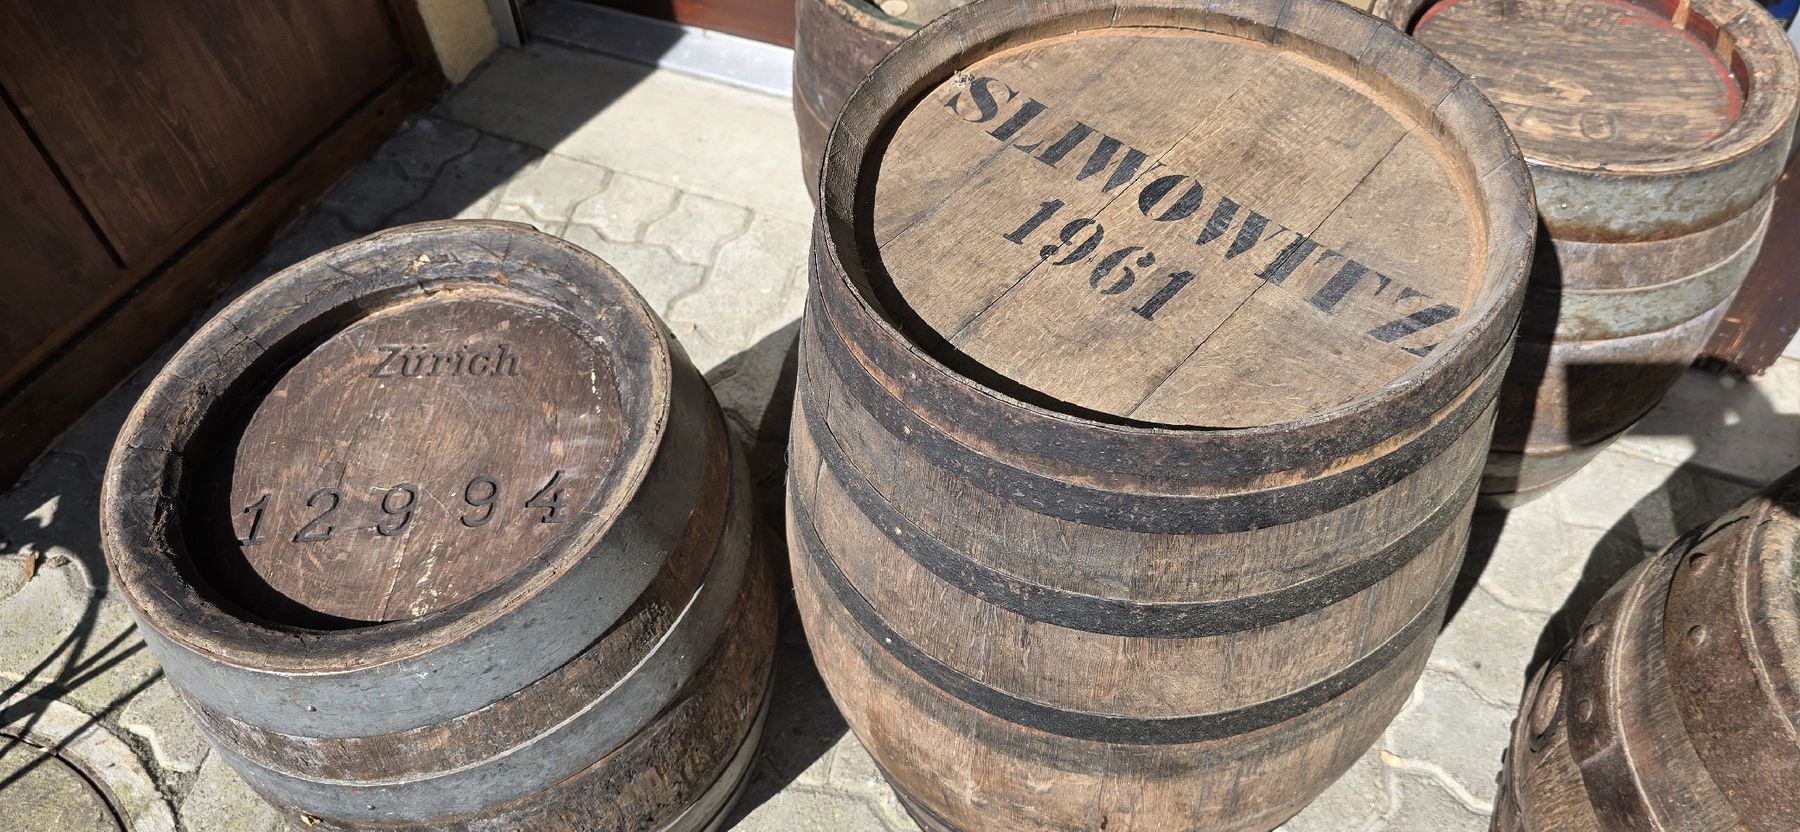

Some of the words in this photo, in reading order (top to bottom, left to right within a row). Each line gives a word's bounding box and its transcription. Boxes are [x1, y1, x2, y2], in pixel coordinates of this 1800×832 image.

[944, 76, 1460, 357] SLIWOWITZ
[1003, 198, 1196, 321] 1961
[370, 343, 522, 378] Zürich
